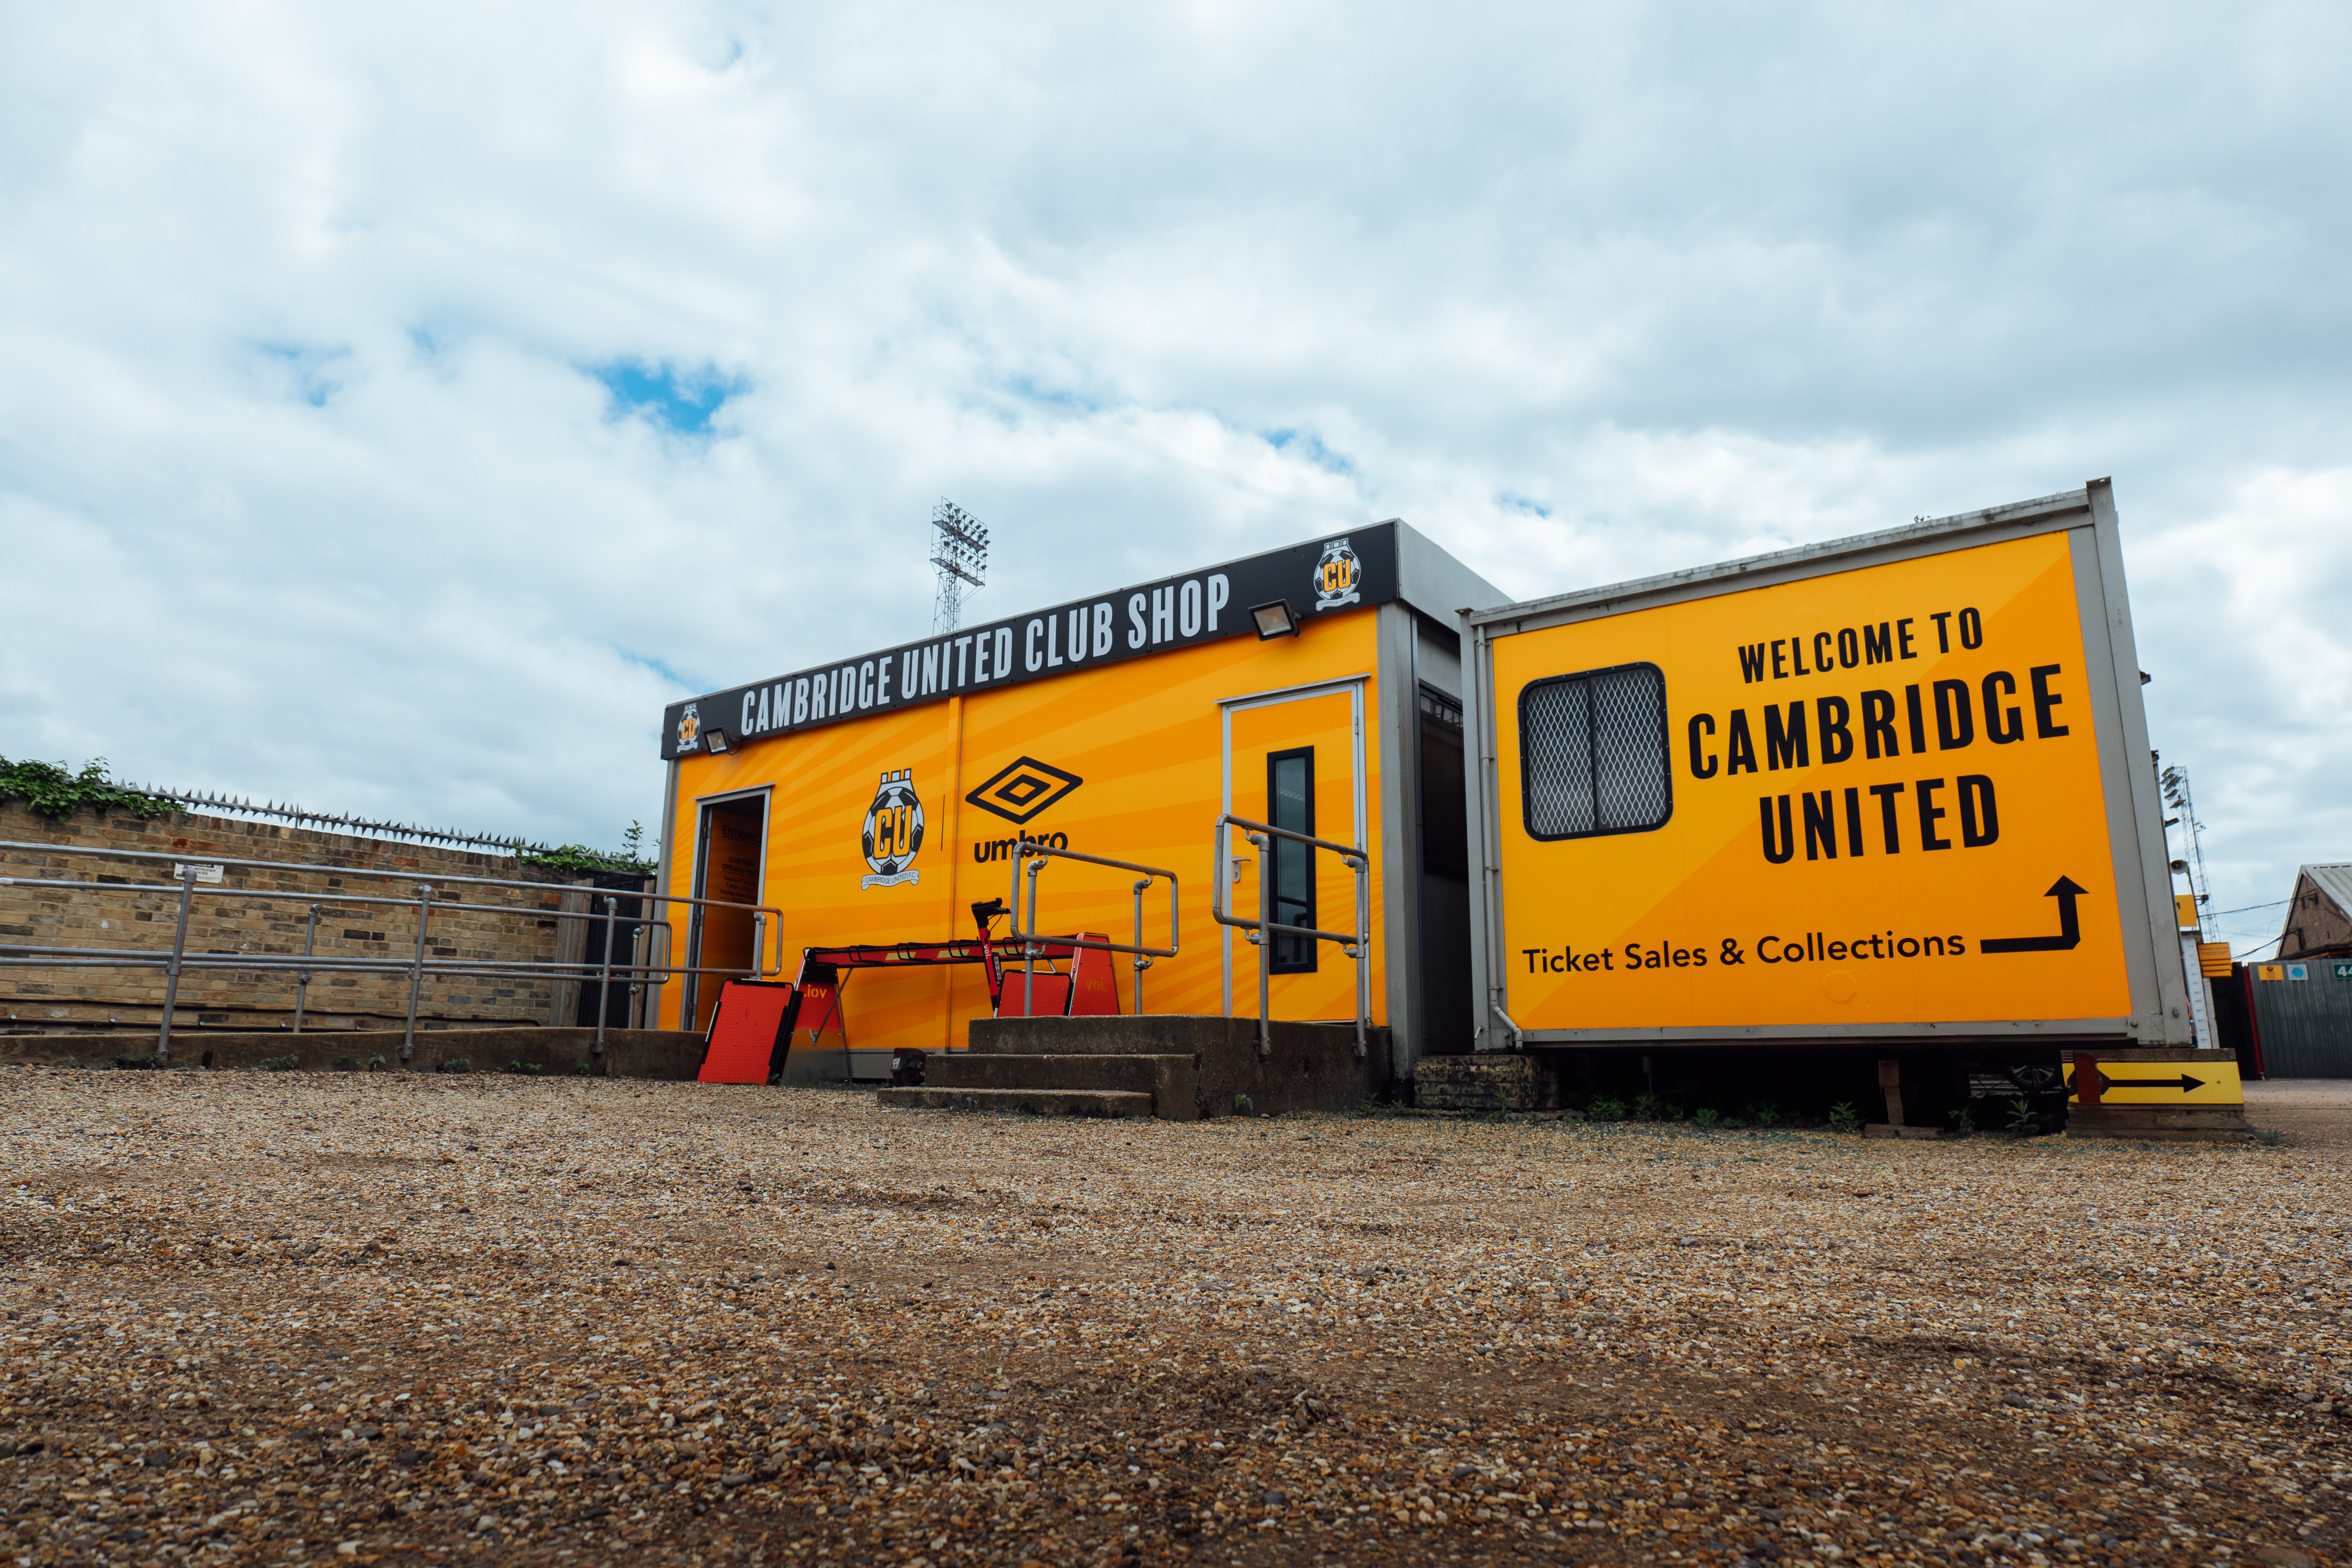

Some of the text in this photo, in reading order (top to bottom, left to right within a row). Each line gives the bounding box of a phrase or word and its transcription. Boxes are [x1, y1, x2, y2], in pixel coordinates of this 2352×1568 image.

[1324, 559, 1351, 591] CU
[740, 573, 1230, 736] CAMBRIDGE UNITED CLUB SHOP
[1738, 607, 1983, 684] WELCOME TO
[681, 717, 696, 740] CU
[1687, 663, 2070, 780] CAMBRIDGE
[722, 825, 762, 844] ENTRANC
[873, 805, 912, 859] CU
[1759, 774, 2000, 864] UNITED
[728, 856, 741, 864] CLUB
[974, 829, 1068, 864] umbro
[891, 873, 908, 883] UNITED
[1522, 930, 1965, 974] Ticket Sales & Collections
